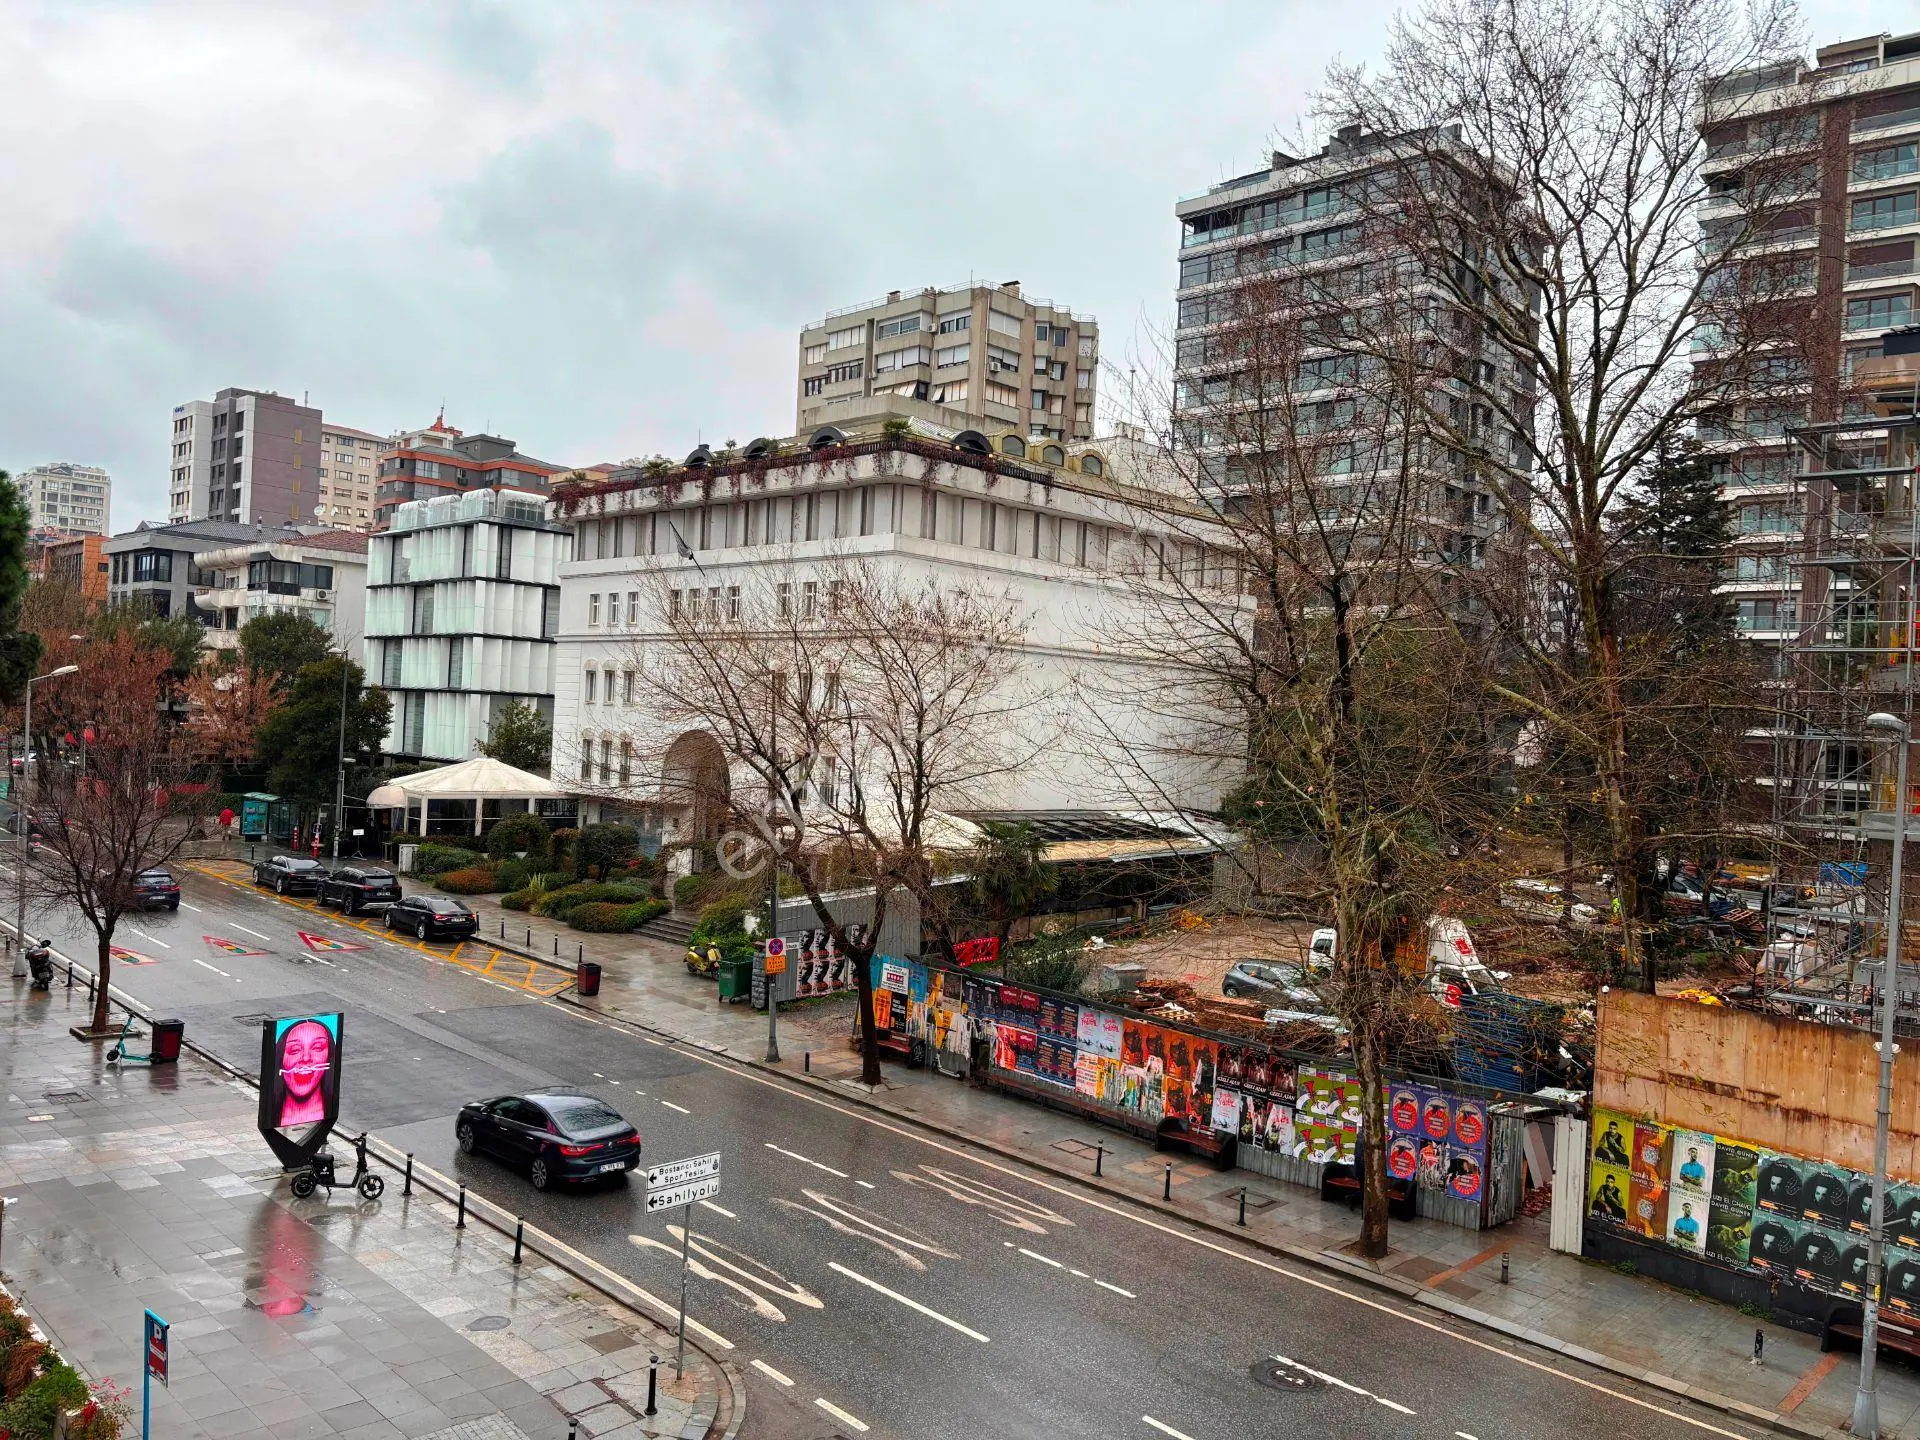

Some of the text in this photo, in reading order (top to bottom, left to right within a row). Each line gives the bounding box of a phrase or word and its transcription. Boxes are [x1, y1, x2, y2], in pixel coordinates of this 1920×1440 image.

[279, 1062, 331, 1077] MAC
[1676, 1133, 1693, 1141] DAVID
[1717, 1145, 1735, 1153] DAVID
[659, 1158, 712, 1175] Bostancı Sahil
[664, 1168, 706, 1183] Spor Tesisi
[658, 1184, 718, 1206] Sahilyolu
[1711, 1201, 1729, 1210] DAVID
